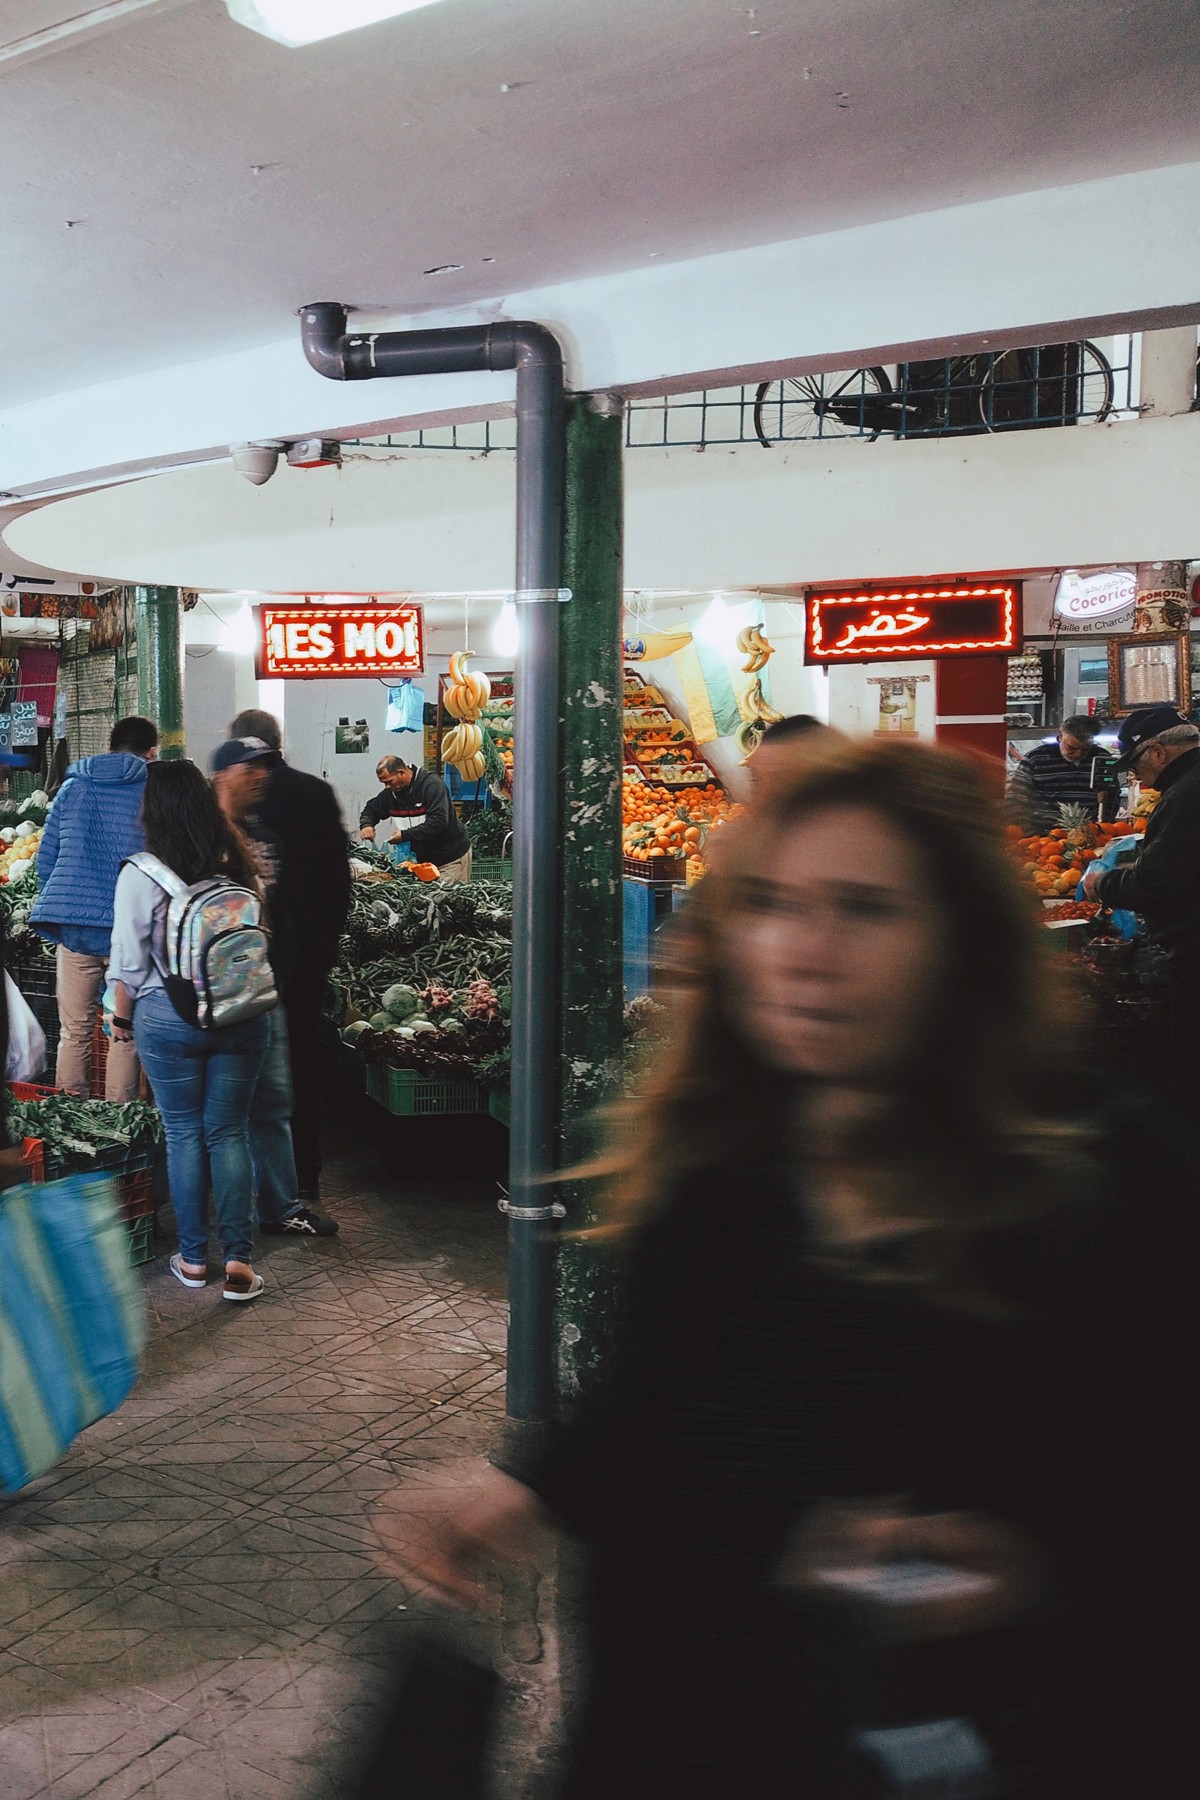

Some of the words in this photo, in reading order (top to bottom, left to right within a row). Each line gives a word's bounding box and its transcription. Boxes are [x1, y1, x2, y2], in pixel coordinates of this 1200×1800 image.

[1069, 586, 1137, 612] Cocorico
[1137, 590, 1187, 605] PROMOTIO
[836, 606, 930, 648] خضر
